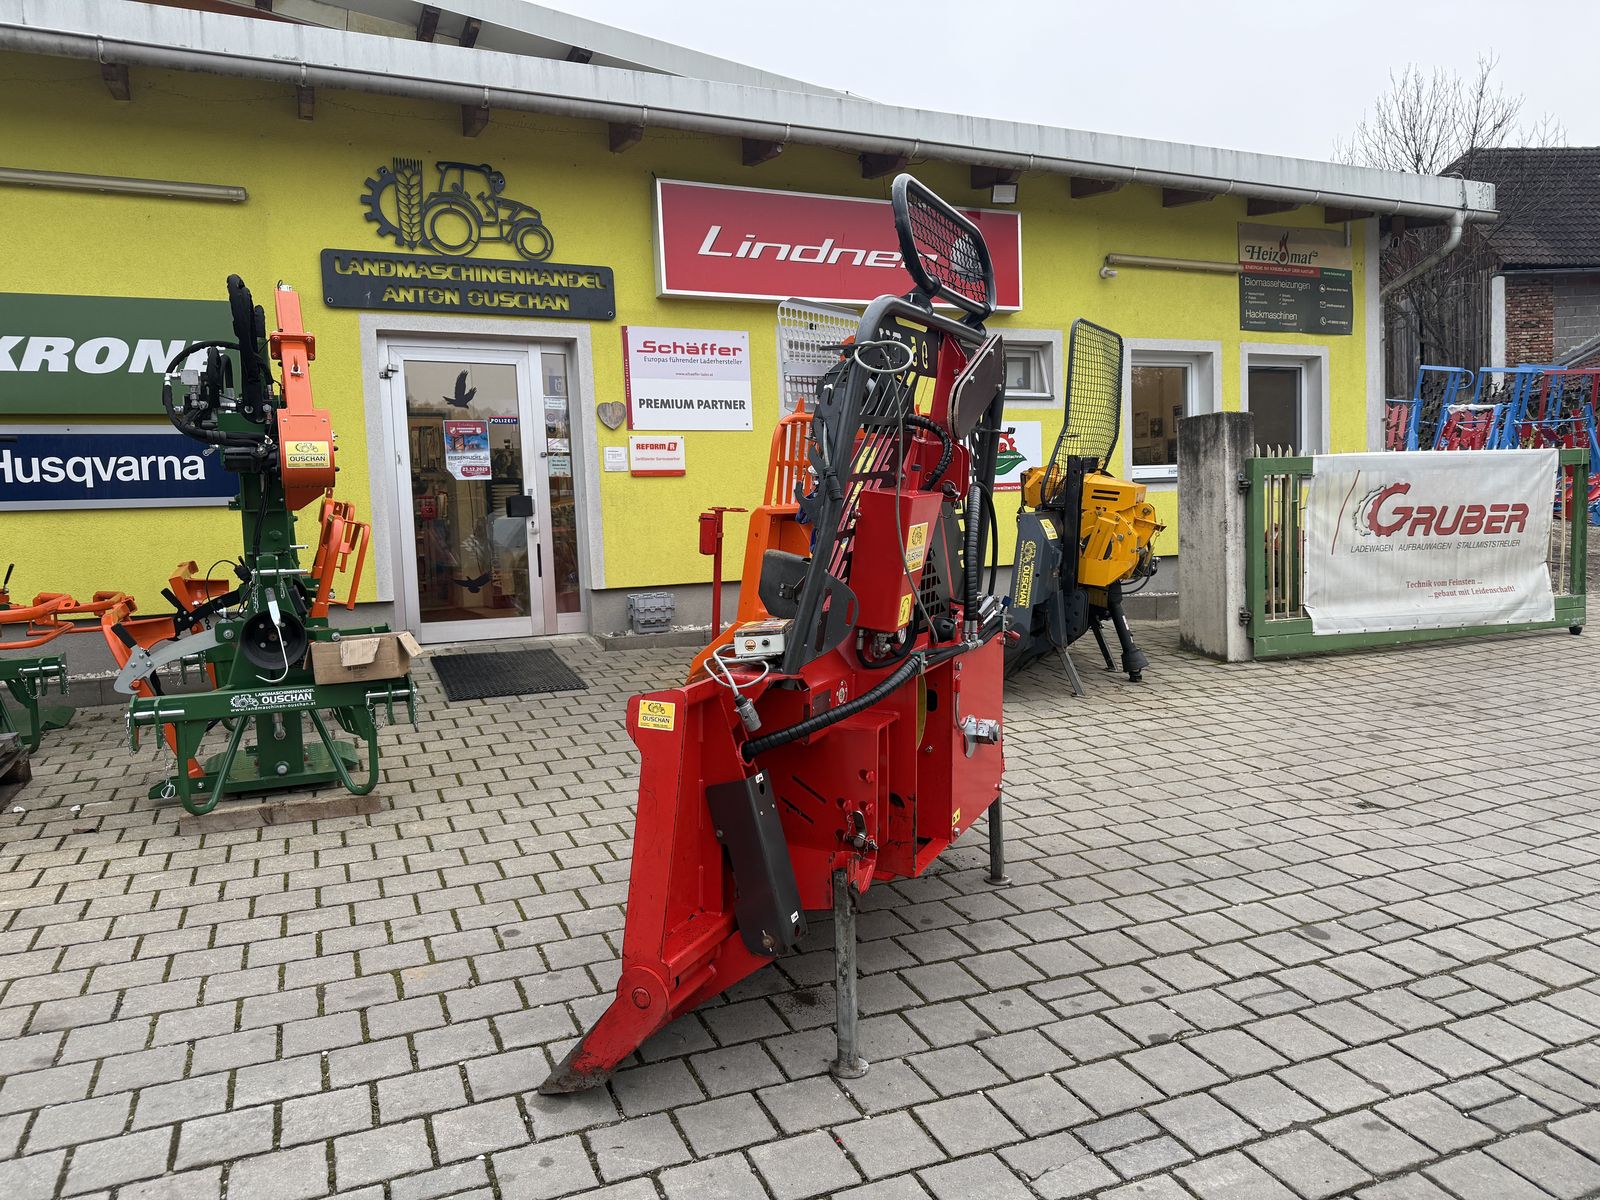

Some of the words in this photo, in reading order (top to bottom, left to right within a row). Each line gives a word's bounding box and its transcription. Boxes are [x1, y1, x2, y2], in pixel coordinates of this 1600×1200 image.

[333, 256, 607, 289] LANDMASCHINENHANDEL
[1244, 277, 1310, 291] Biomasseheizungen
[382, 285, 461, 305] ANTON
[467, 288, 570, 312] OUSCHAN
[1245, 309, 1297, 321] Hackmaschinen
[637, 340, 742, 356] Schäffer
[643, 356, 668, 364] Europas
[669, 356, 699, 364] führender
[700, 357, 742, 365] Laderhersteller
[638, 398, 694, 409] PREMIUM
[697, 399, 746, 410] PARTNER
[0, 449, 206, 488] Husqvarna
[1367, 482, 1530, 537] GRUBER
[1350, 544, 1394, 553] LADEWAGEN
[1399, 542, 1452, 551] AUFBAUWAGEN
[1456, 539, 1521, 549] STALLMISTSTREUER
[1019, 565, 1030, 606] OUSCHAN
[1406, 580, 1432, 589] Technik
[1448, 578, 1476, 587] Feinsten
[1434, 589, 1457, 599] gebaut
[1471, 585, 1516, 595] Leidenschaft!
[254, 688, 315, 697] LANDMASCHINENHANDEL
[261, 693, 312, 704] OUSCHAN
[642, 715, 670, 724] OUSCHAN
